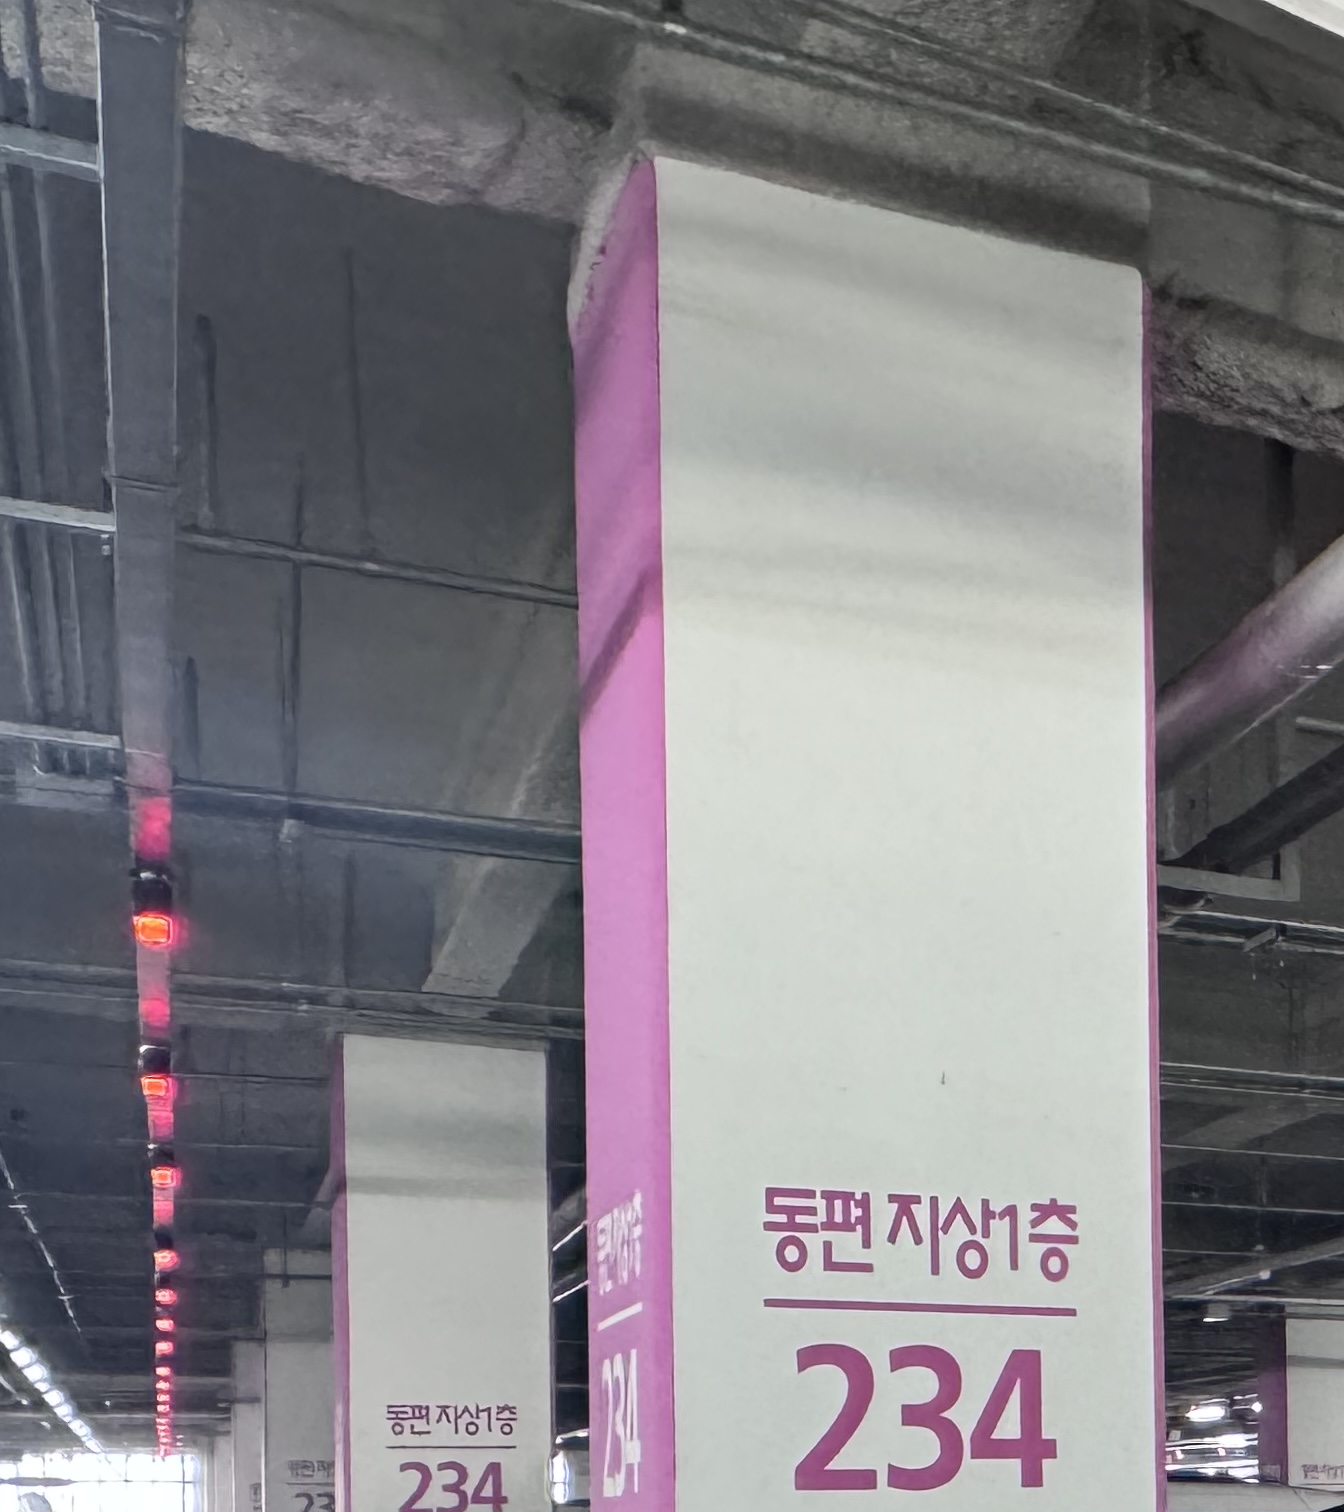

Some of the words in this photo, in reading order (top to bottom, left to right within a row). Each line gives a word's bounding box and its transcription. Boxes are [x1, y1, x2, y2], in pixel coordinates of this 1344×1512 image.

[763, 1187, 875, 1273] 동편
[886, 1193, 1079, 1283] 지상1층
[386, 1403, 432, 1436] 동편
[435, 1402, 518, 1436] 지상1층
[602, 1349, 641, 1498] 234
[794, 1343, 1058, 1491] 234
